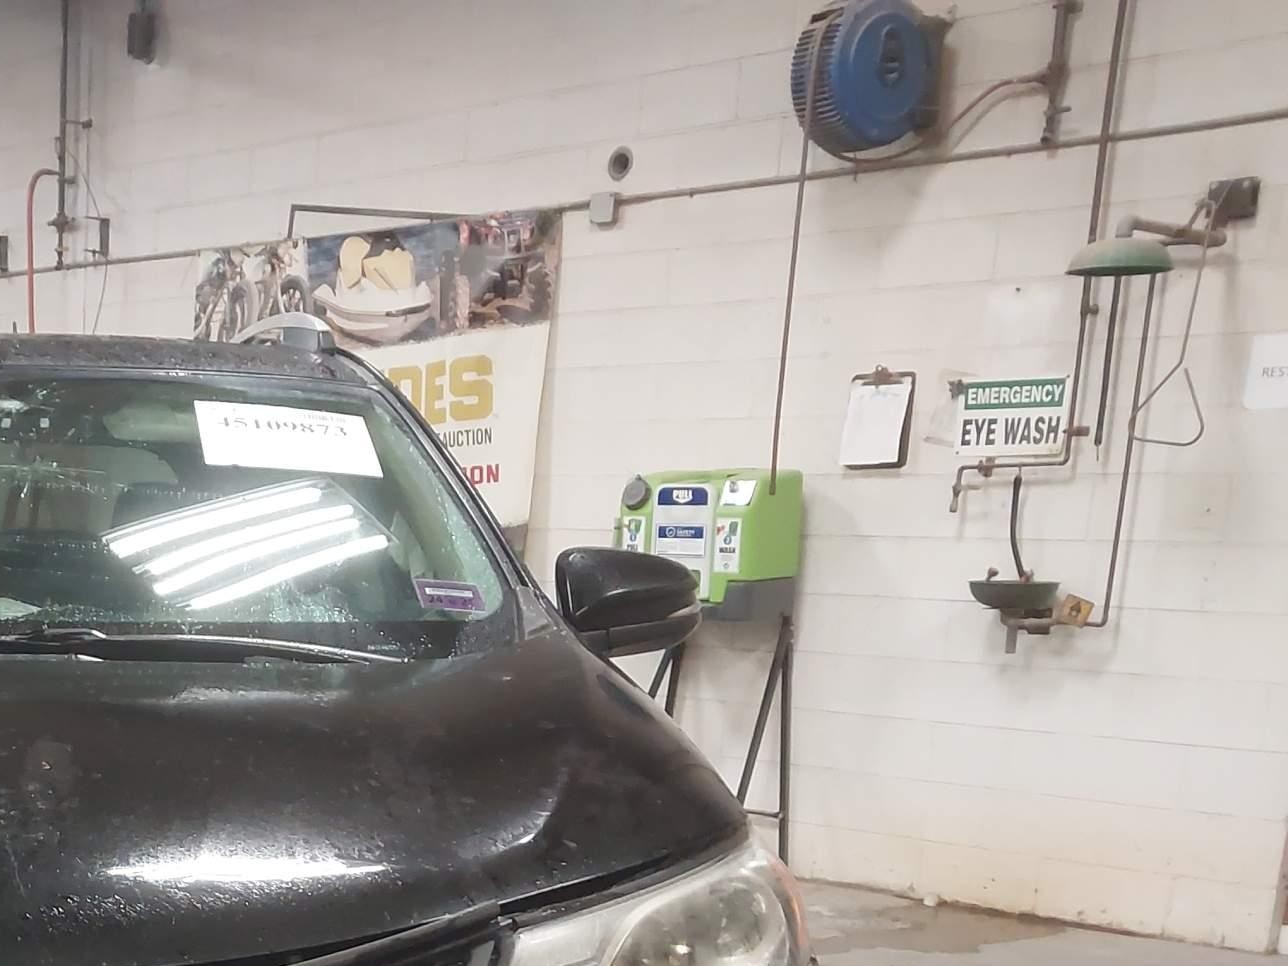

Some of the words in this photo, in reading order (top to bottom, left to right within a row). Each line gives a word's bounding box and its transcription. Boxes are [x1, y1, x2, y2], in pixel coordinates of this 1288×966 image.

[967, 384, 1064, 405] EMERGENCY
[960, 417, 998, 447] EYE
[1004, 415, 1061, 445] WASH
